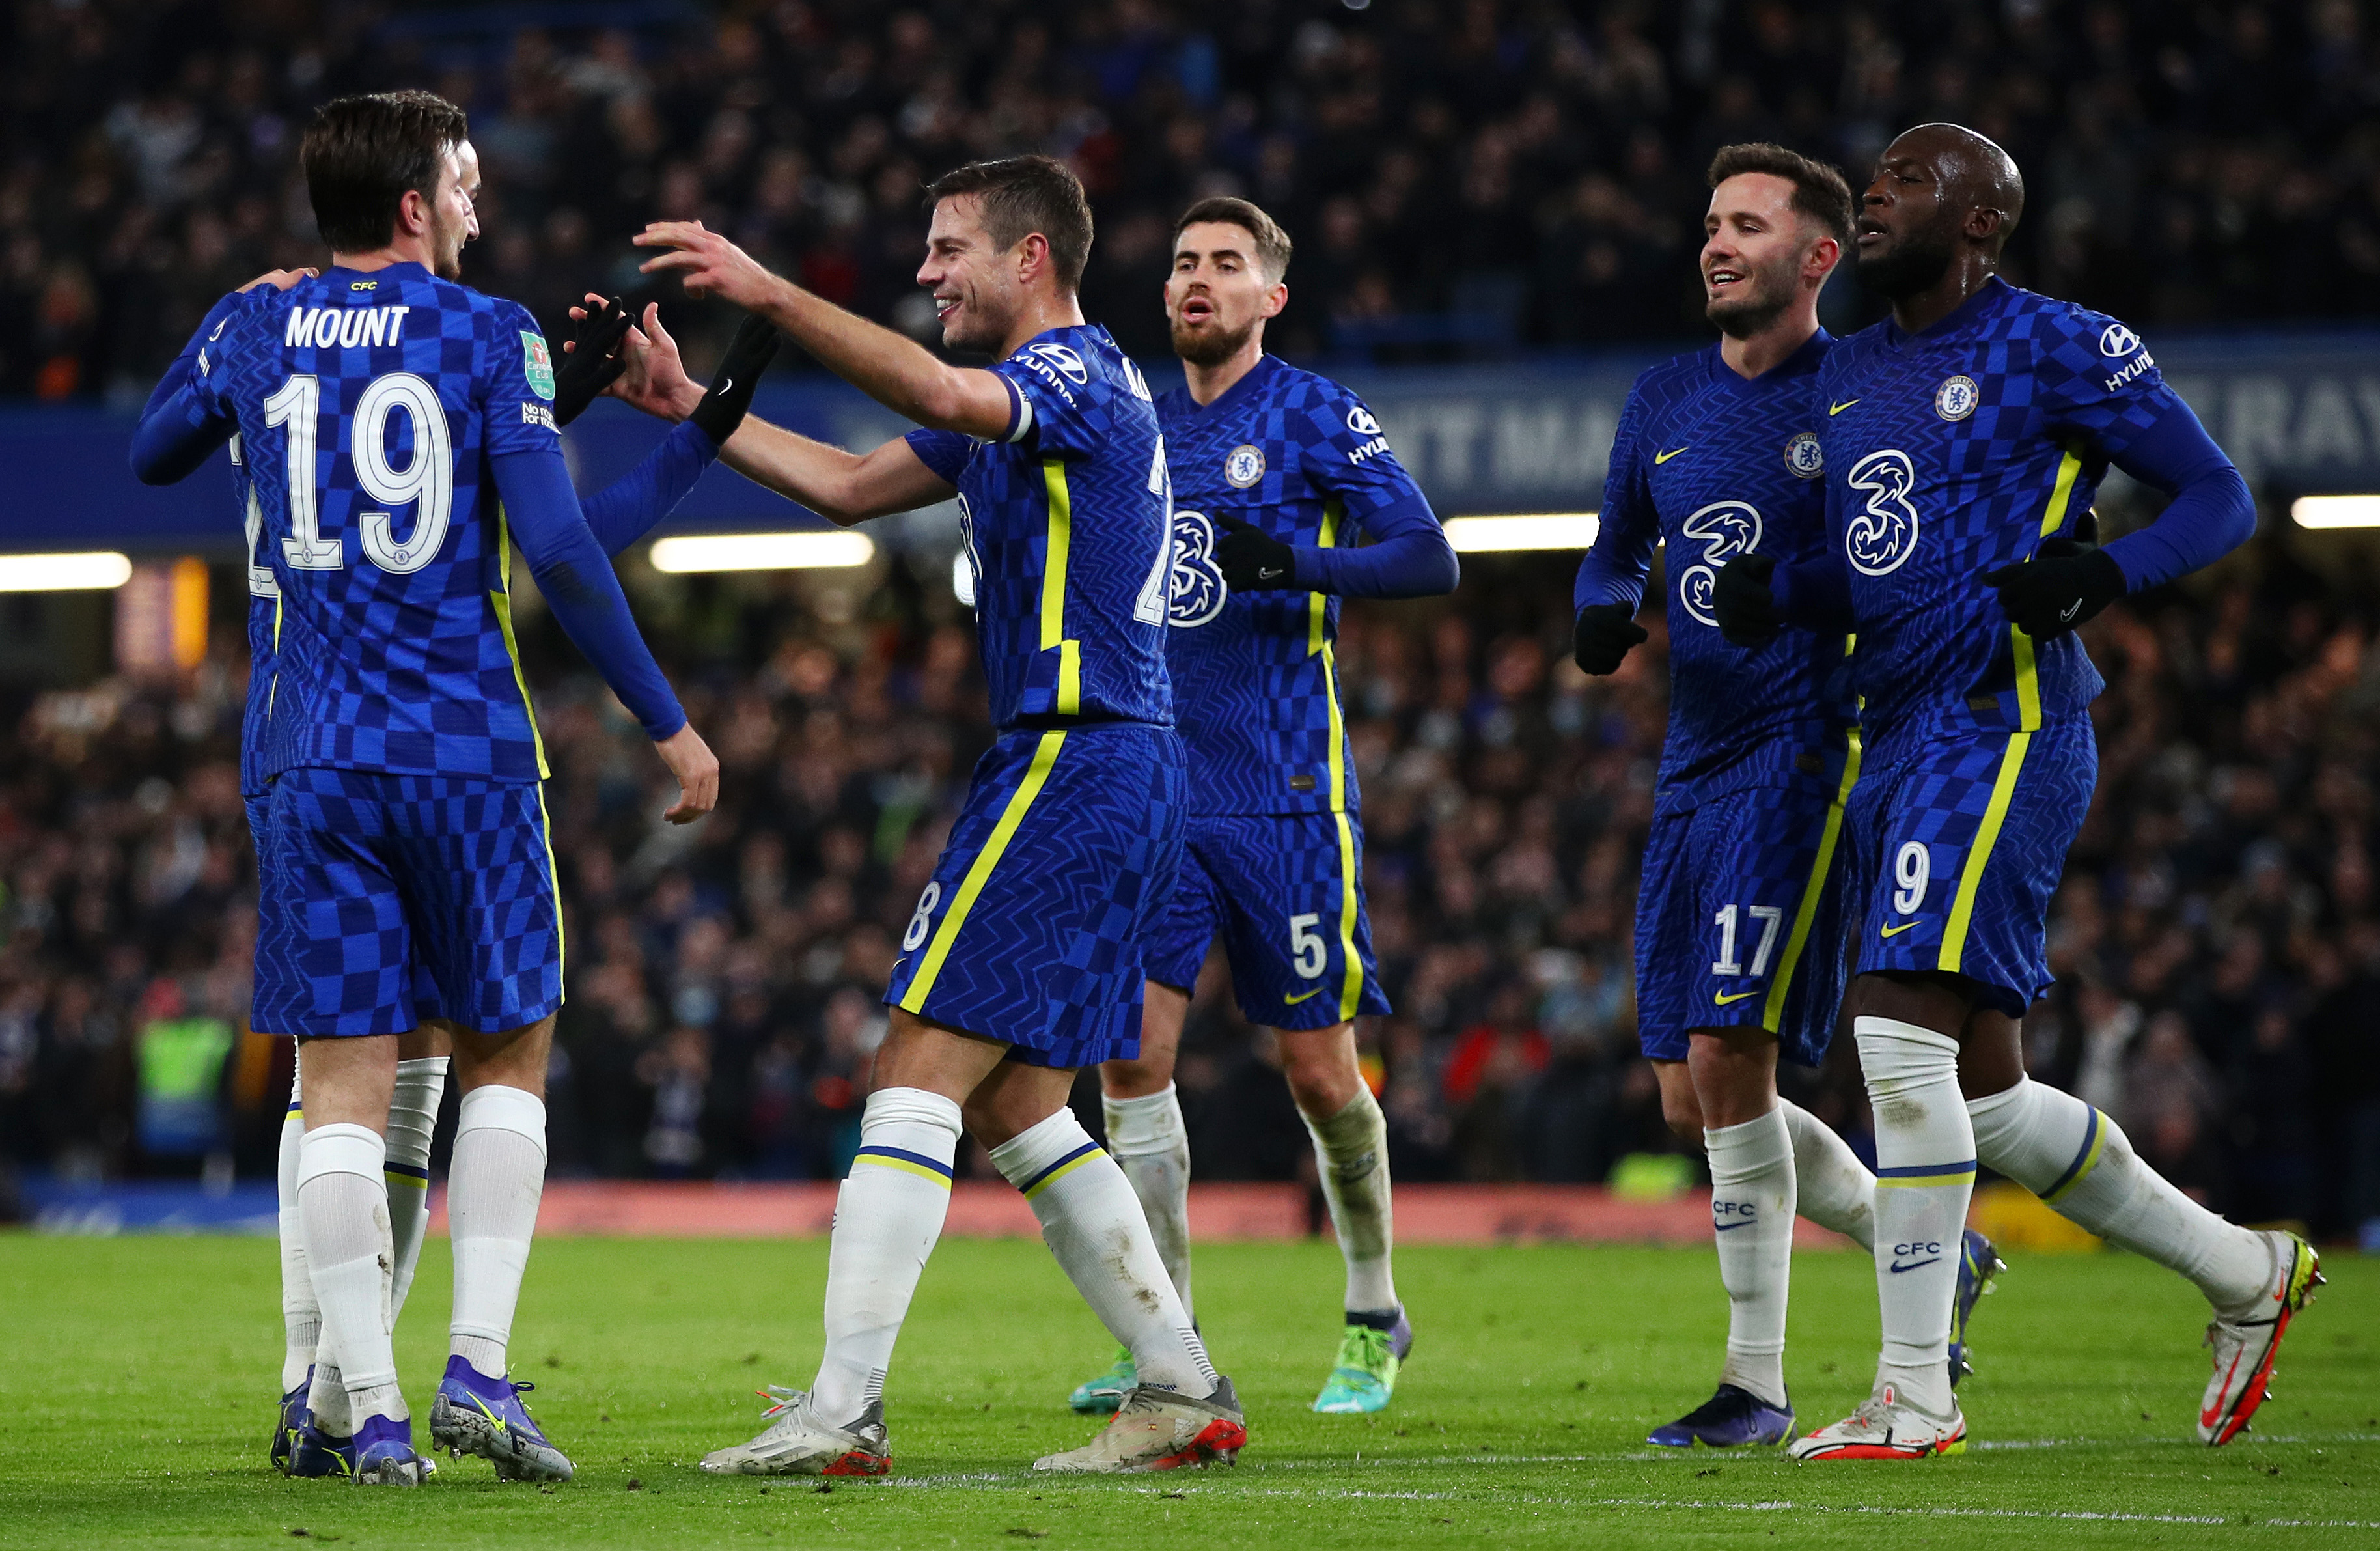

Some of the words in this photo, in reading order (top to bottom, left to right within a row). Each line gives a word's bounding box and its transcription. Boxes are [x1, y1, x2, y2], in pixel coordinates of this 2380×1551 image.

[350, 281, 378, 291] CFC
[284, 306, 409, 348] MOUNT
[522, 402, 539, 415] No
[264, 372, 452, 575] 19
[1846, 449, 1919, 576] 3
[1894, 841, 1931, 915] 9
[903, 881, 941, 952] 8
[1290, 912, 1328, 980] 5
[1712, 904, 1782, 977] 17
[1713, 1201, 1756, 1216] CFC
[1894, 1242, 1941, 1256] CFC
